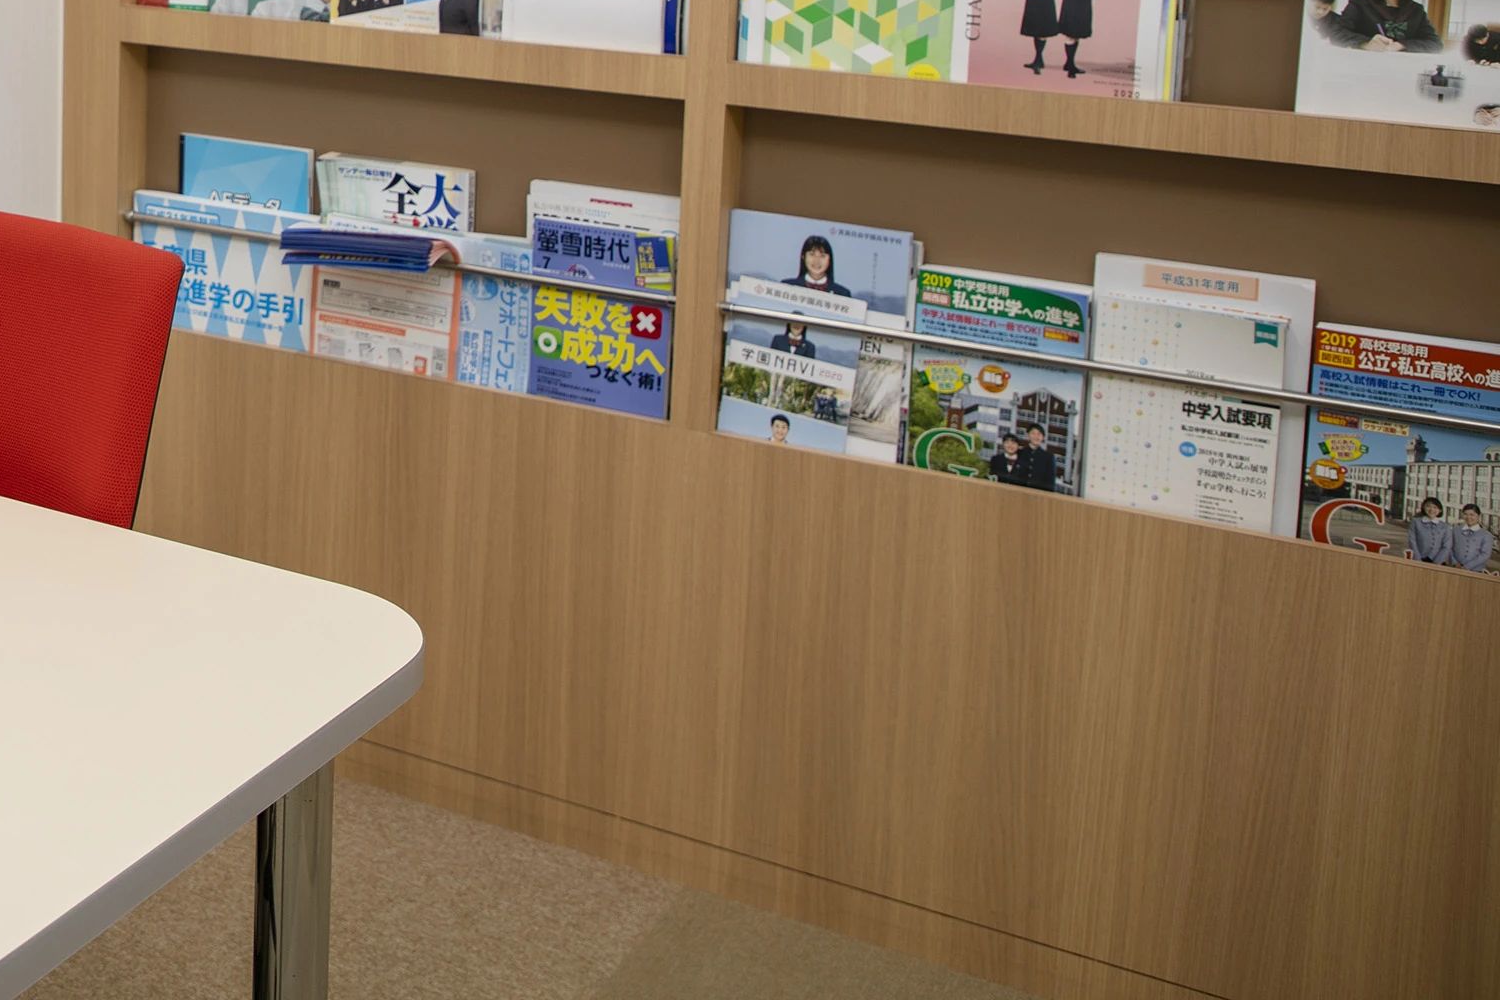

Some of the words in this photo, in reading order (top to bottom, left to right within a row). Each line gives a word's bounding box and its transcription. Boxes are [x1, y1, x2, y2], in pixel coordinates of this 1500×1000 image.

[537, 228, 631, 264] 螢雪時代
[922, 273, 952, 288] 2019
[954, 279, 1009, 297] 中学受験用
[1161, 273, 1240, 293] 平成31年度用
[534, 285, 632, 334] 失敗を
[952, 290, 1080, 327] 私立中学への進学
[560, 329, 666, 375] 成功へ
[1320, 331, 1356, 348] 2019
[1360, 337, 1429, 358] 高校受験用
[1182, 401, 1273, 430] 中学入試要項
